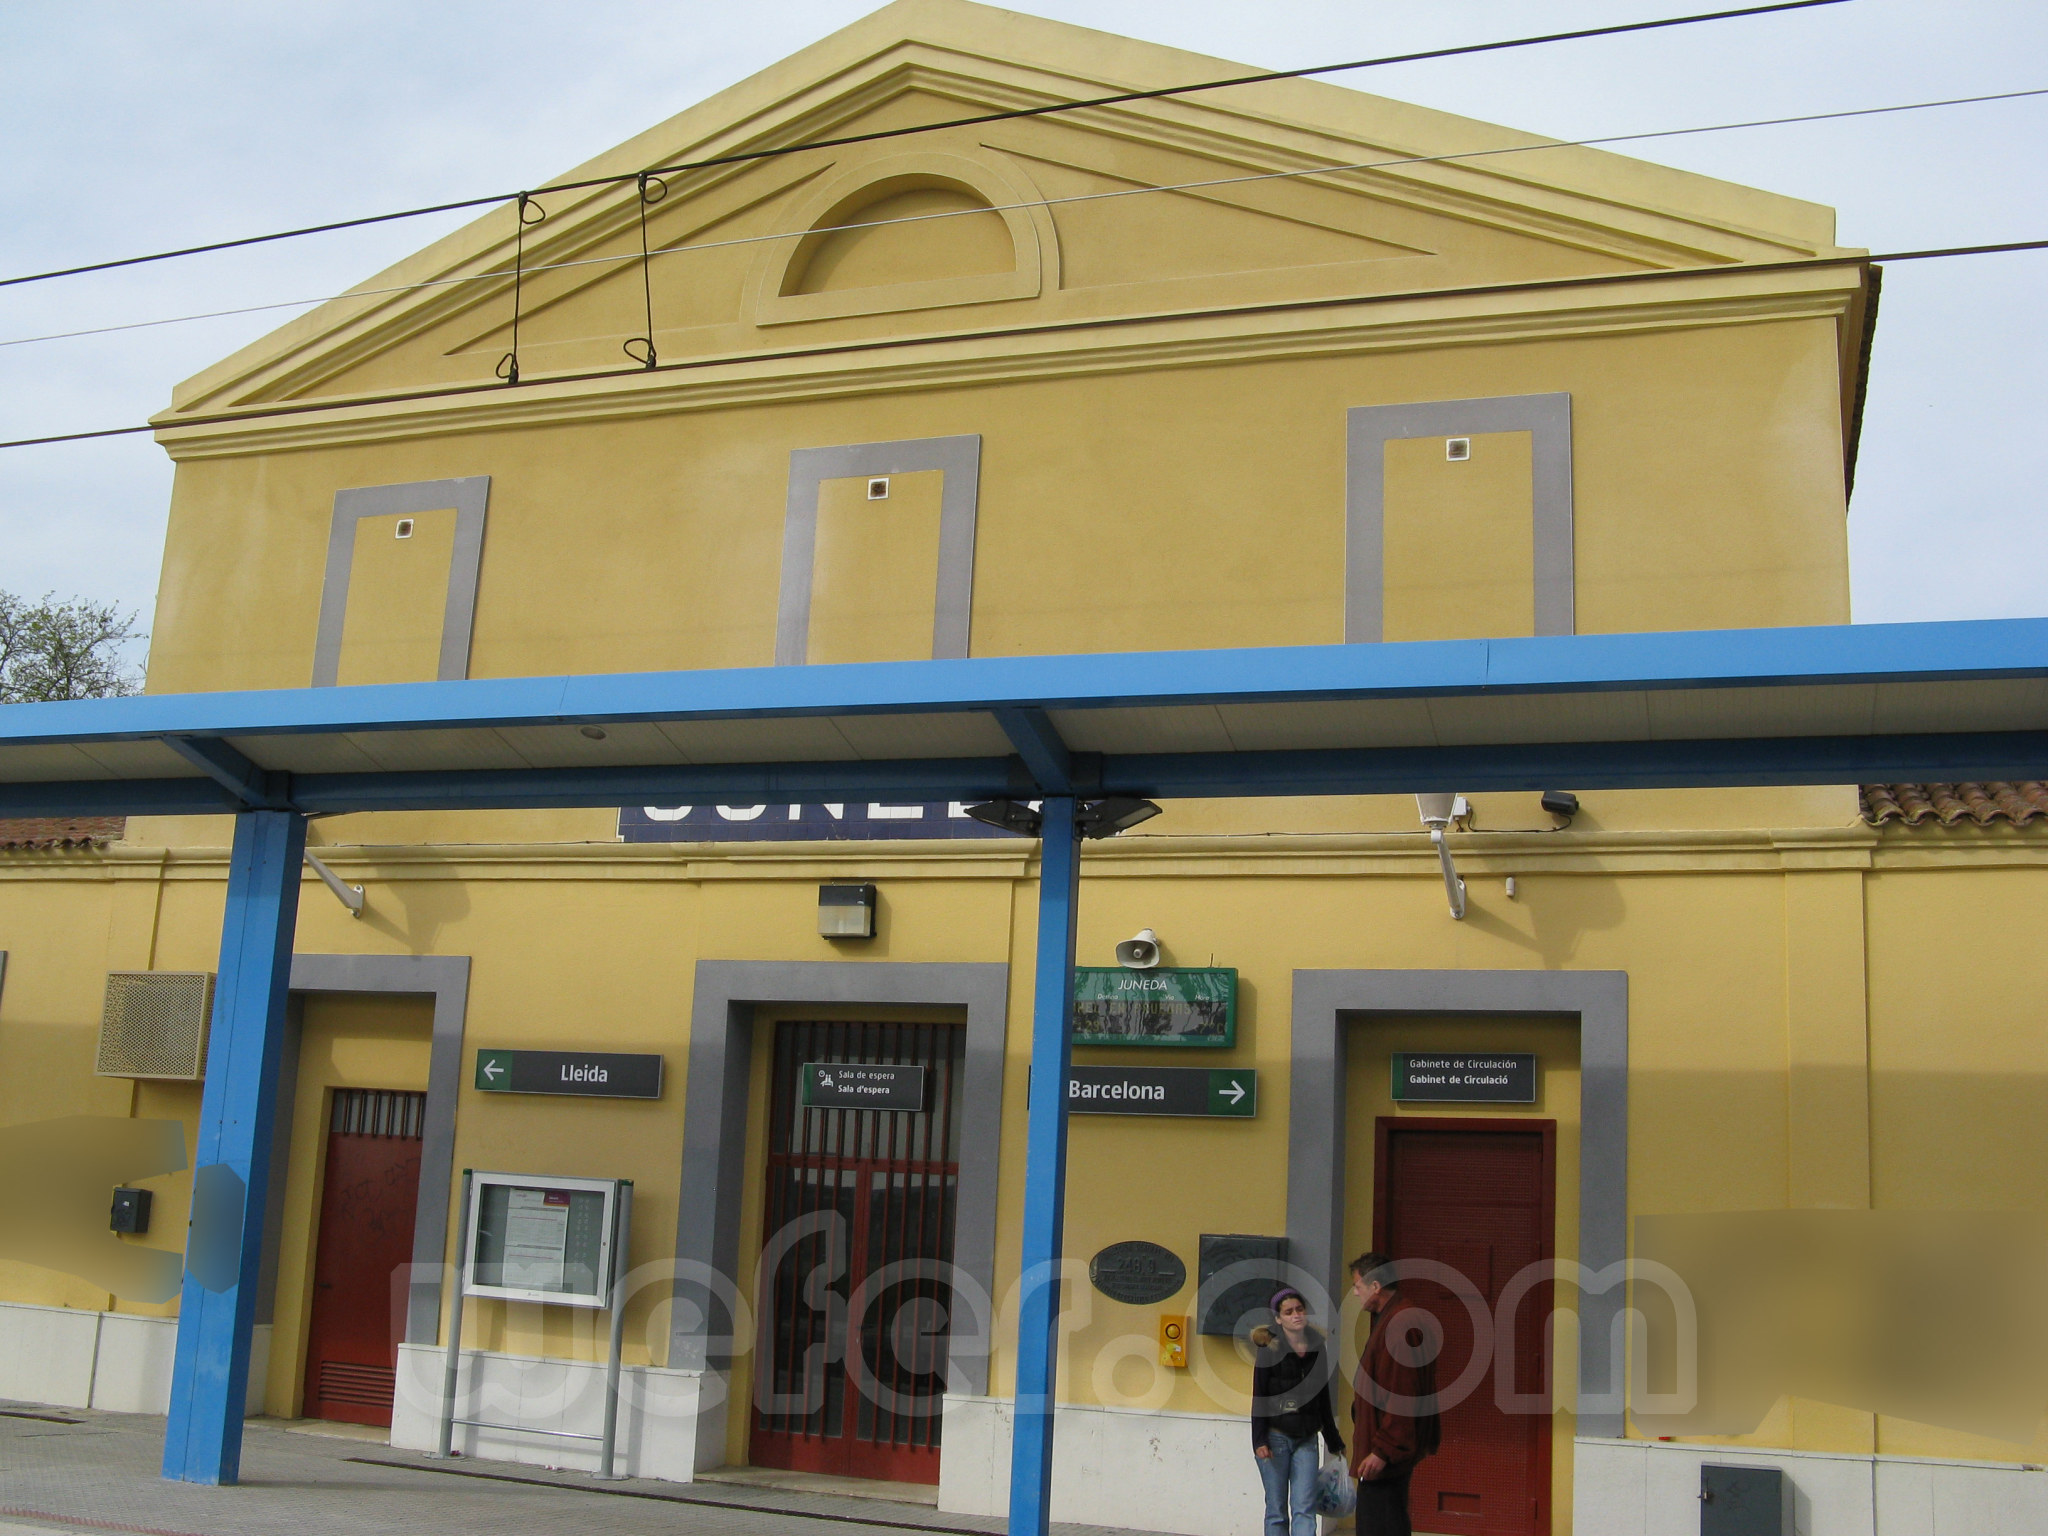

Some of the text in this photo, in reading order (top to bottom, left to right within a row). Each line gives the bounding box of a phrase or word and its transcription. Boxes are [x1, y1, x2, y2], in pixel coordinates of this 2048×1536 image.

[1117, 979, 1168, 991] JUNEDA
[1409, 1059, 1517, 1069] Gabinete de Circulación
[561, 1064, 608, 1083] Lleida
[839, 1070, 895, 1081] Sala de espera
[1409, 1074, 1508, 1085] Gabinet de Circulació
[838, 1084, 890, 1096] Sala d'espera
[1068, 1080, 1165, 1100] Barcelona
